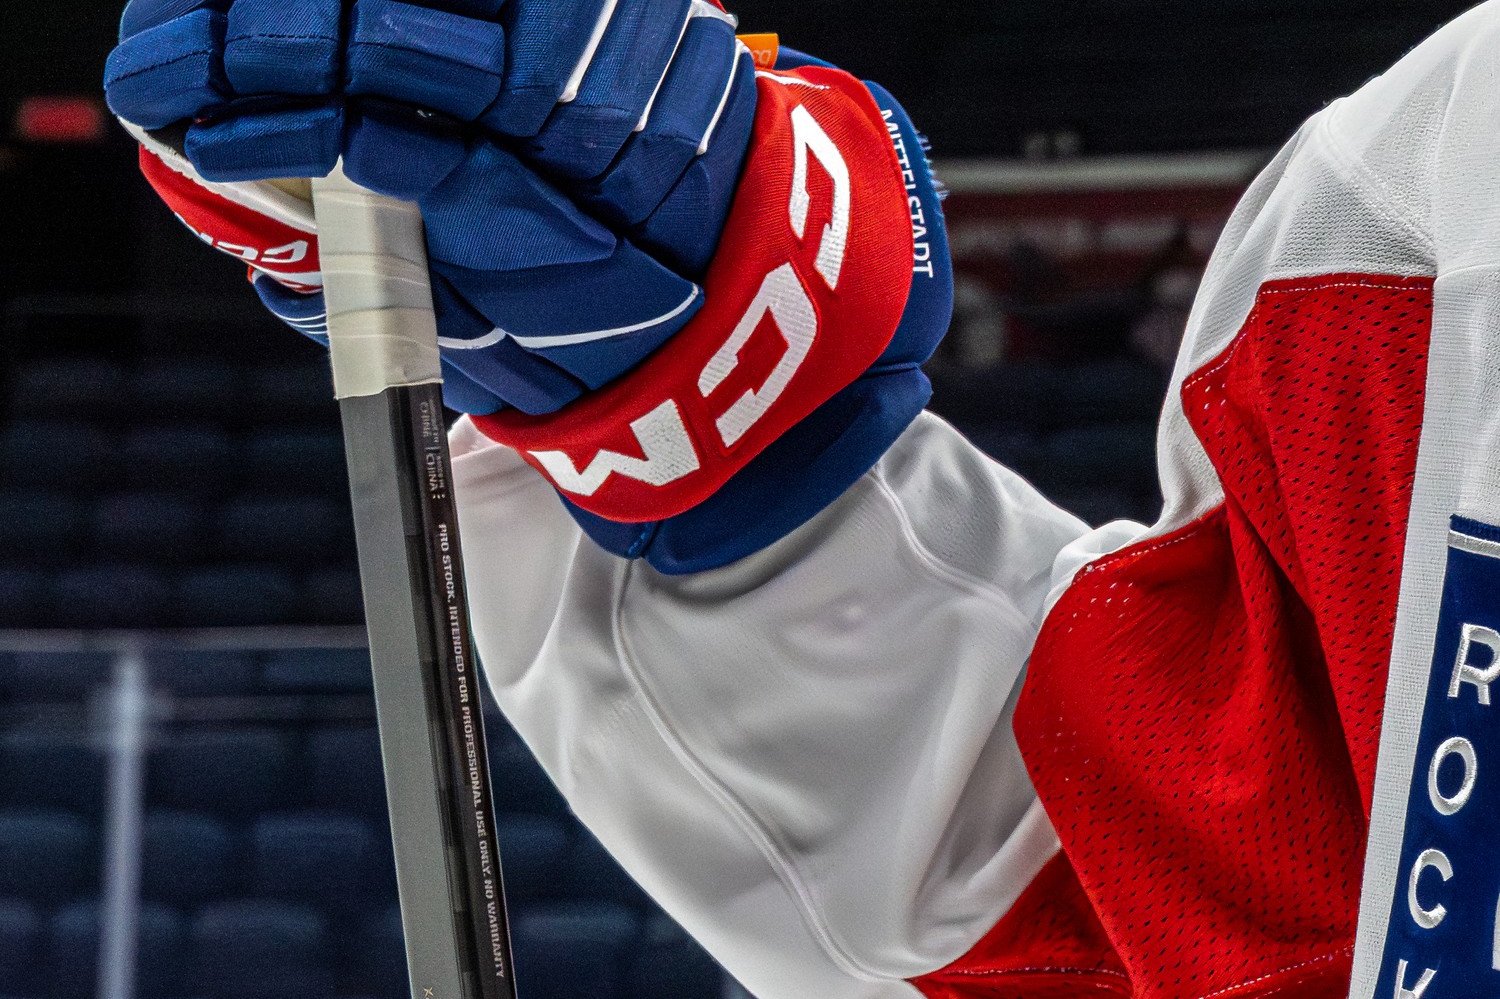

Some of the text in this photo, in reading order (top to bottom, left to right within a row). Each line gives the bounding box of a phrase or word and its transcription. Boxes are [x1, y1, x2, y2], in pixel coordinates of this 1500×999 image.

[527, 103, 851, 497] CCM
[438, 523, 449, 552] PRO
[449, 606, 465, 673] INTENDED
[458, 676, 469, 703] FOR
[462, 706, 482, 808] PROFESSIONAL
[475, 810, 487, 837] USE
[484, 879, 495, 899] NO
[488, 901, 504, 978] WARRANTY
